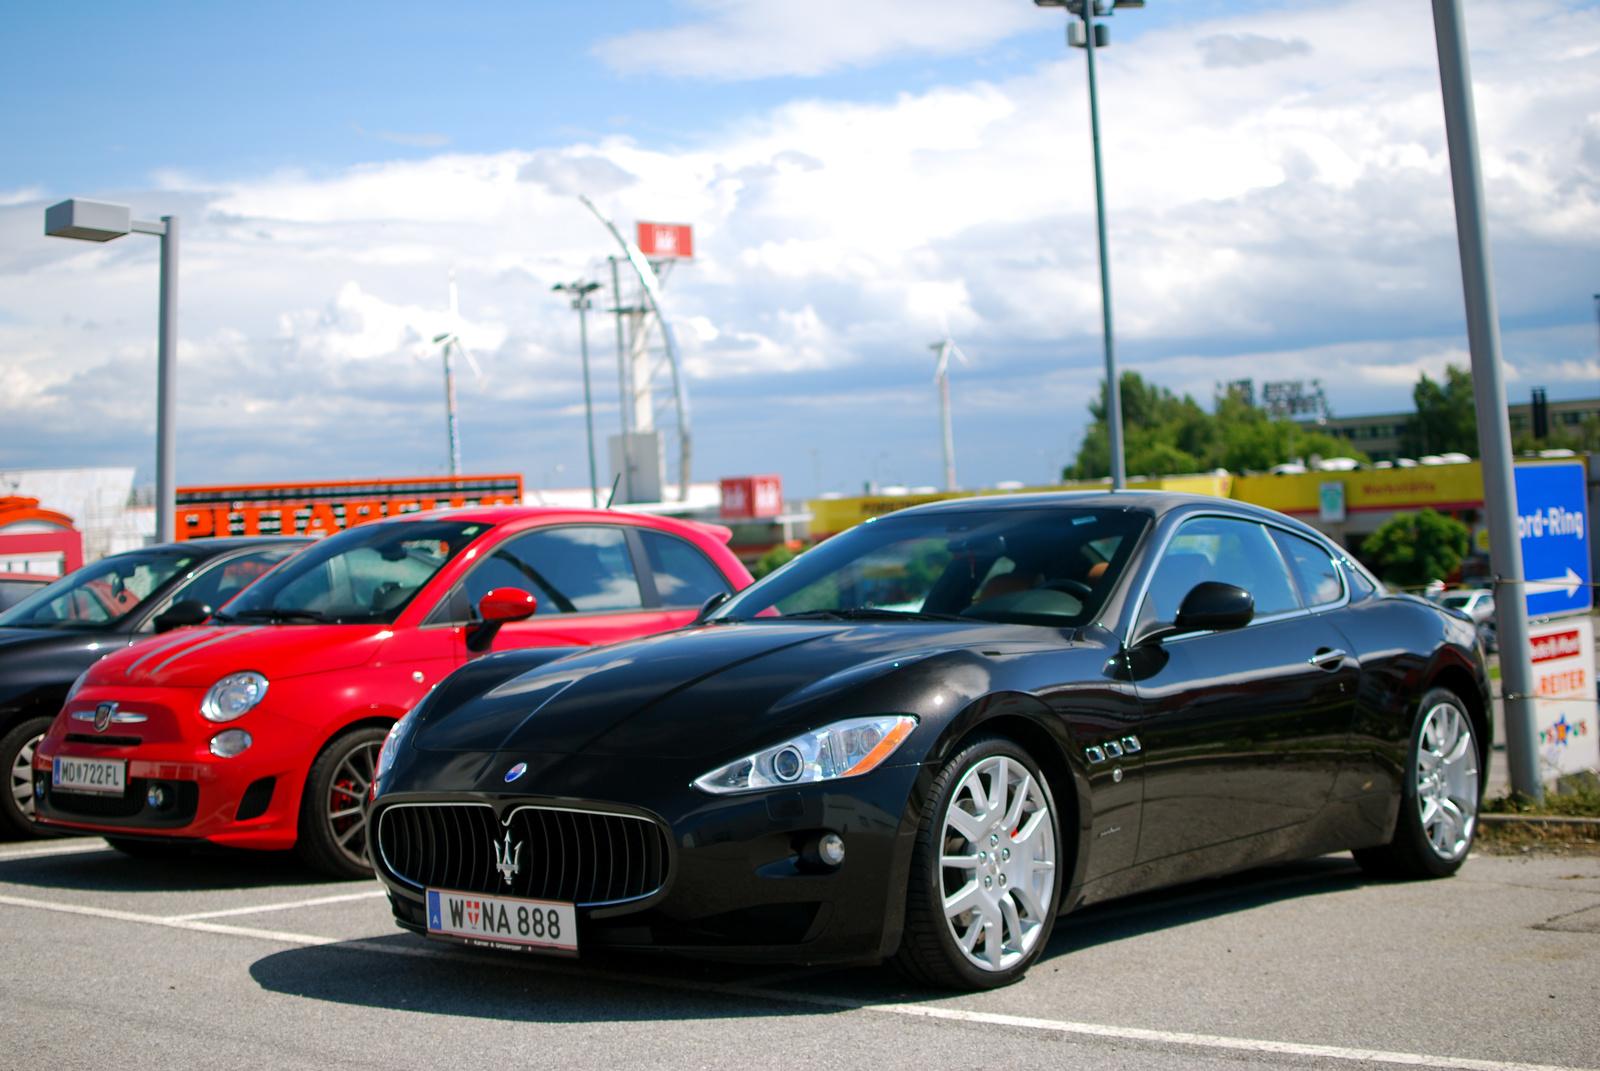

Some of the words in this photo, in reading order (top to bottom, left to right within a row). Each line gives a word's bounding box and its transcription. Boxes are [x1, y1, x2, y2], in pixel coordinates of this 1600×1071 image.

[1541, 669, 1586, 695] REITER
[105, 765, 119, 786] FL
[432, 915, 439, 925] A
[449, 898, 464, 928] W
[482, 901, 511, 935] NA
[517, 906, 561, 939] 888
